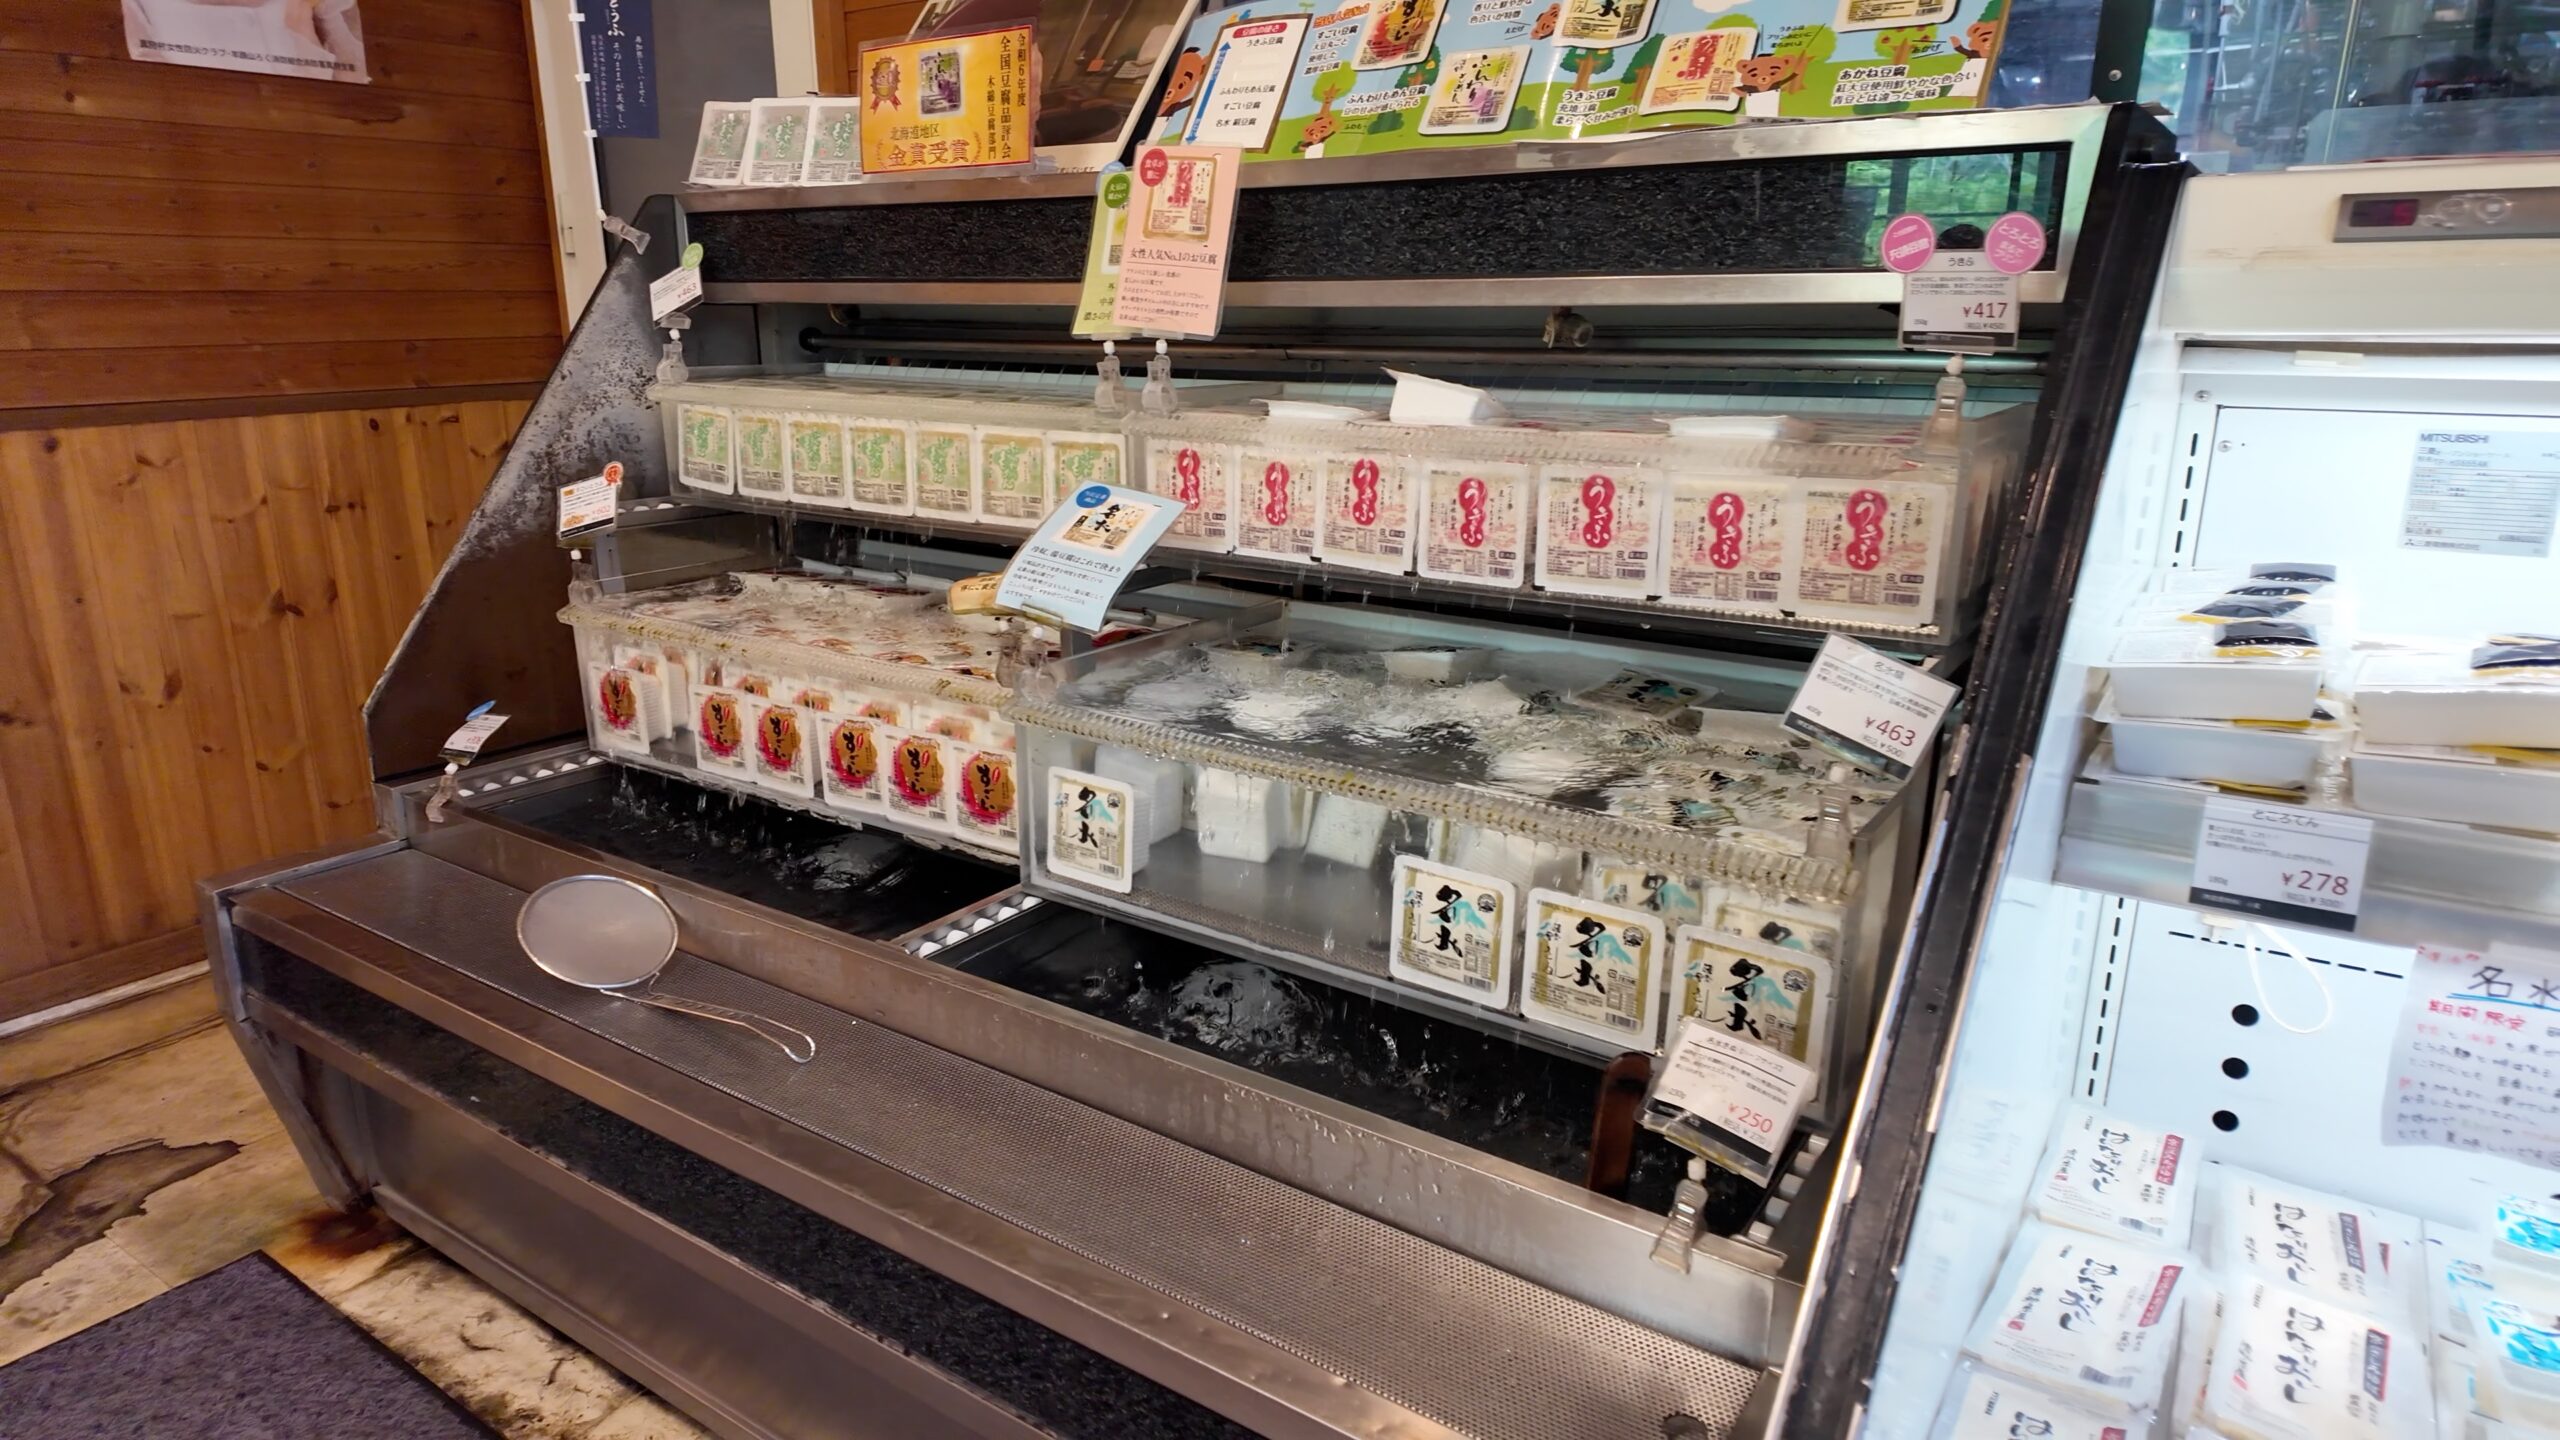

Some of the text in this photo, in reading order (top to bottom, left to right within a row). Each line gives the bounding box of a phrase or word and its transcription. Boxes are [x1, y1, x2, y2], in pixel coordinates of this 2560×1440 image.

[1246, 37, 1284, 47] うきふ豆腐
[1317, 25, 1358, 39] すごい豆腐
[1017, 33, 1027, 107] 令和6年度
[1840, 66, 1907, 80] あかね豆腐
[1000, 35, 1011, 159] 全国豆腐品評会
[1223, 101, 1262, 110] すごい豆腐
[1347, 86, 1427, 104] ふんわりもめん豆腐
[1564, 89, 1617, 101] うきふ豆腐
[890, 123, 941, 142] 北海道地区
[888, 139, 970, 168] 金賞受賞
[1130, 247, 1218, 265] 女性人気No.1のお豆腐
[1949, 257, 1974, 267] うきふ
[1963, 302, 2009, 319] ¥417
[2420, 433, 2490, 444] MITSUBISHI
[1864, 716, 1916, 747] ¥463
[842, 731, 861, 776] すごい
[907, 747, 926, 792] すごい
[976, 763, 996, 811] すごい
[1074, 786, 1099, 848] 名水
[2251, 809, 2319, 828] ところてん
[2281, 870, 2349, 896] ¥278
[1430, 884, 1463, 958] 名水
[1569, 917, 1606, 995] 名水
[1723, 959, 1764, 1041] 名水
[2465, 965, 2560, 1009] 名水
[1728, 1103, 1773, 1134] ¥250
